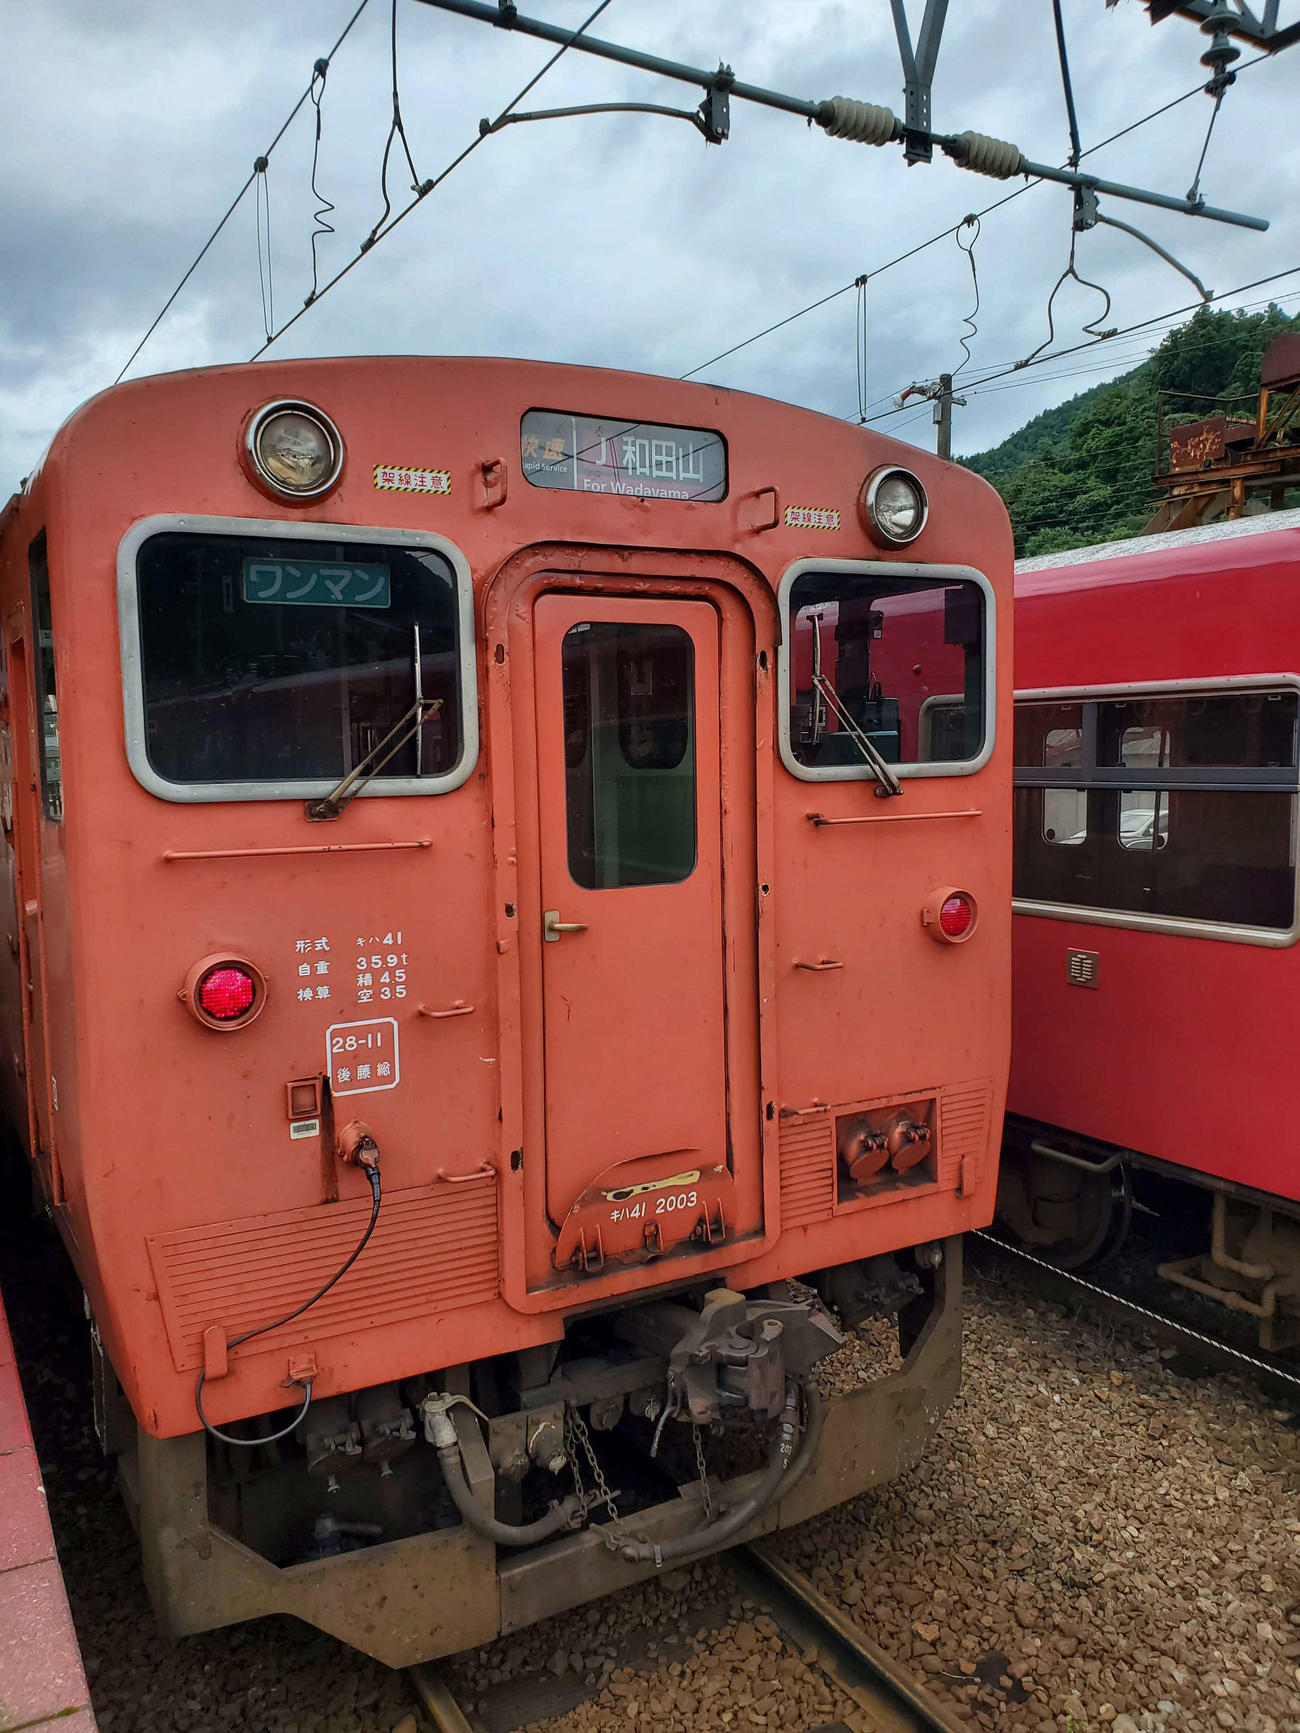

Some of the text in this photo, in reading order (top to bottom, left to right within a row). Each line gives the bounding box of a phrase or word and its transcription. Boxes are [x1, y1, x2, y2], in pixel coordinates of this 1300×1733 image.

[541, 463, 568, 473] Service
[622, 435, 704, 482] 和田山
[381, 470, 444, 490] 架線注意
[583, 479, 607, 493] For
[790, 511, 835, 526] 架線注意
[249, 564, 385, 602] ワンマン
[295, 931, 402, 954] 形式 キハ41
[298, 960, 331, 976] 自重
[357, 968, 407, 987] 積 4.5
[296, 984, 407, 1003] 換算 空 3.5
[332, 1031, 382, 1053] 28-11
[610, 1191, 698, 1223] キハ41 2003
